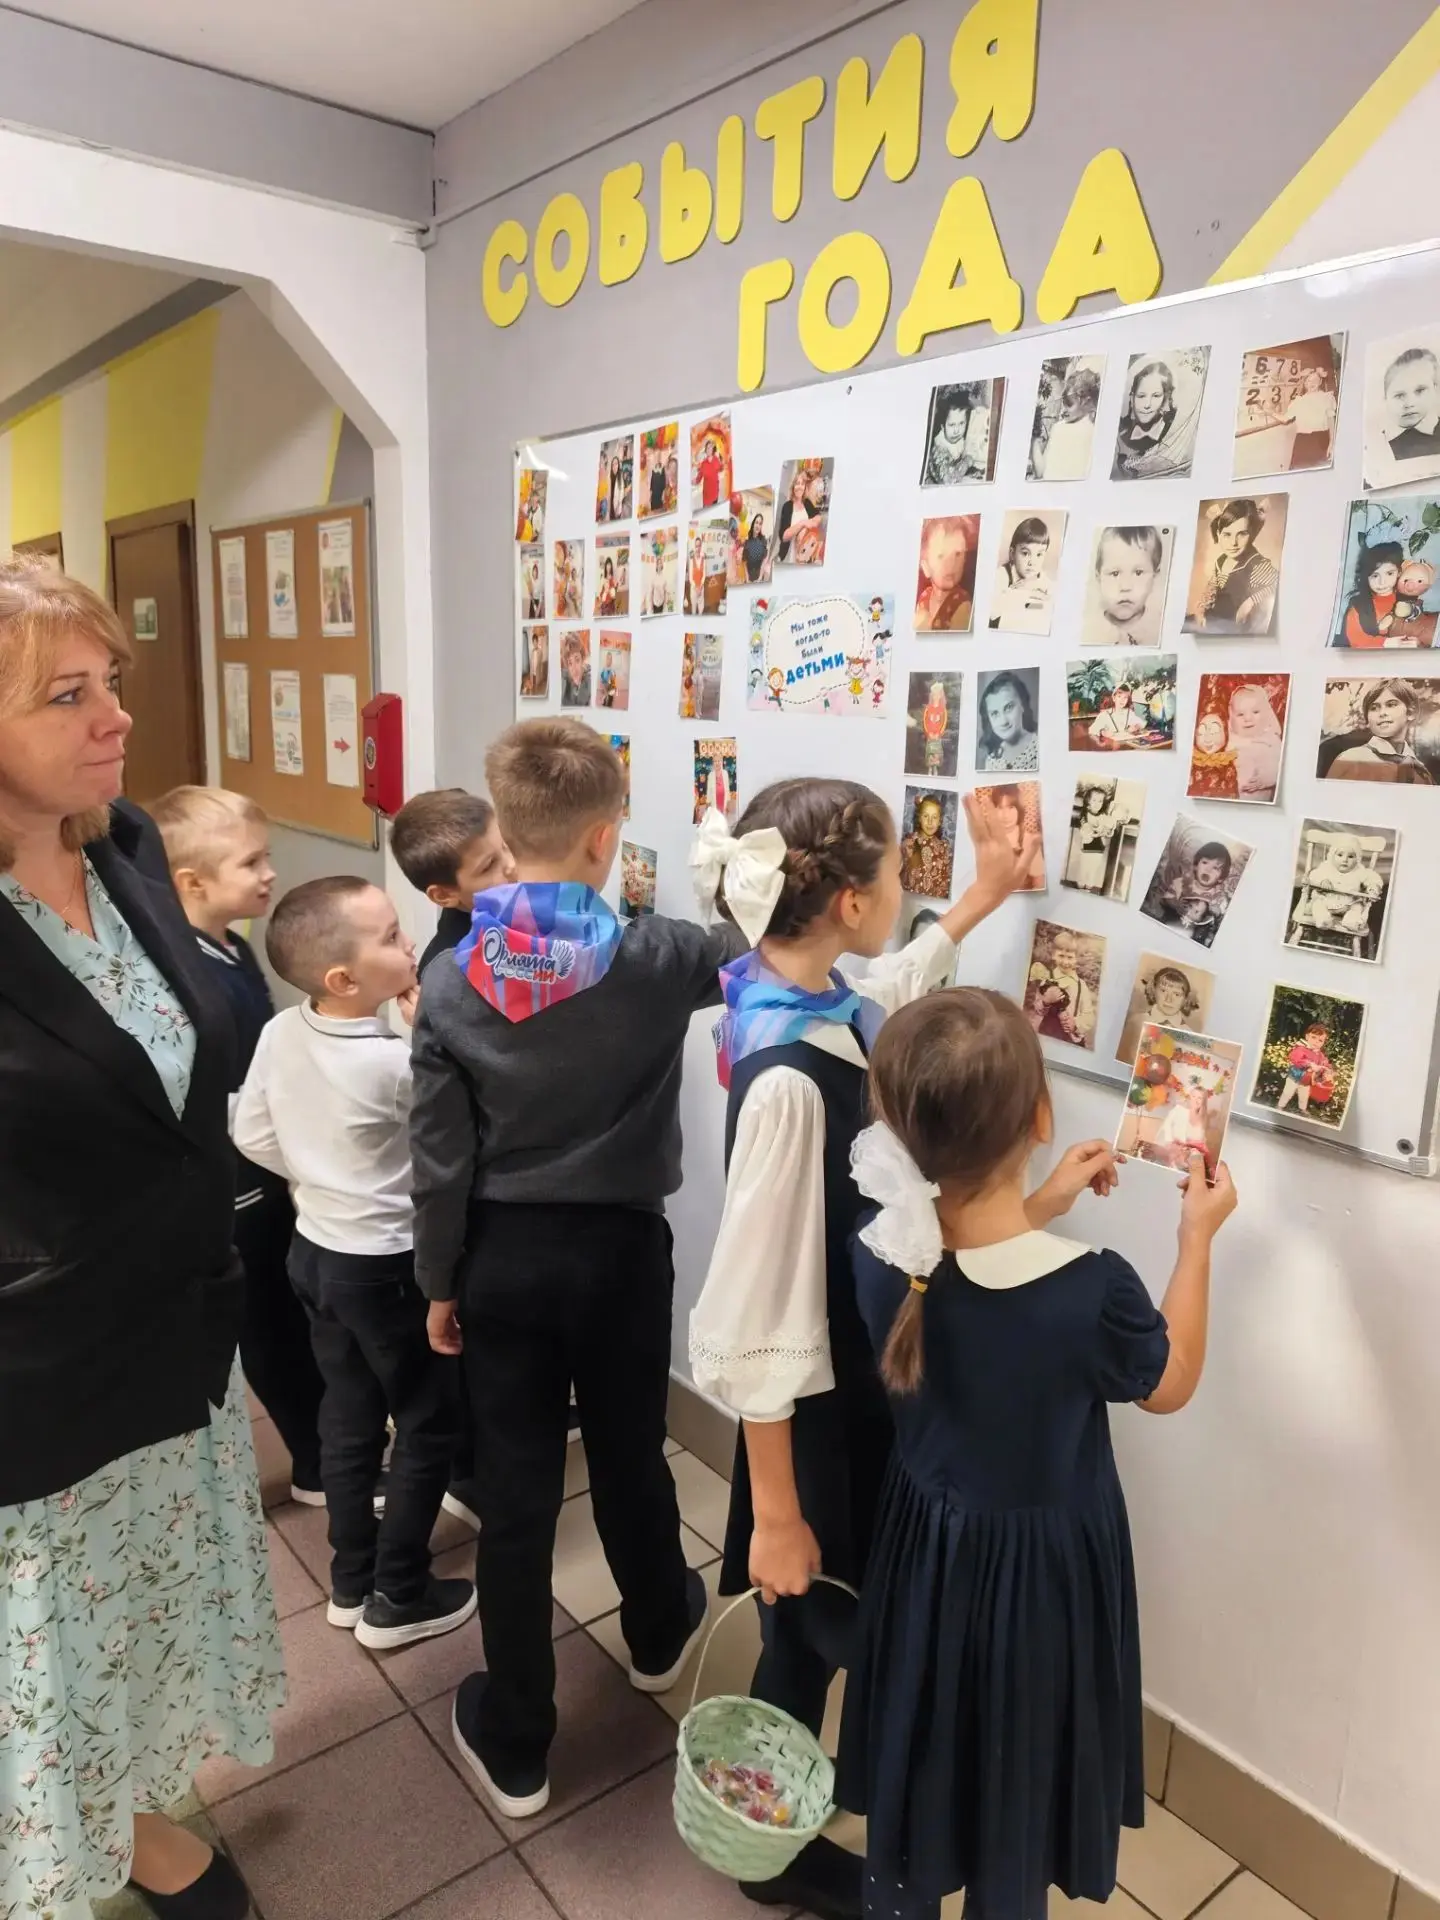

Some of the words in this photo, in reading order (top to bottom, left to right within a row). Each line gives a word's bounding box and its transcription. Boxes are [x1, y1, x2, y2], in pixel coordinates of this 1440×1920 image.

[482, 0, 1041, 327] СОБЫТИЯ
[737, 147, 1163, 392] ГОДА
[790, 623, 805, 634] Мы
[807, 614, 829, 628] тоже
[786, 652, 845, 685] детьми
[484, 929, 556, 971] Орлята
